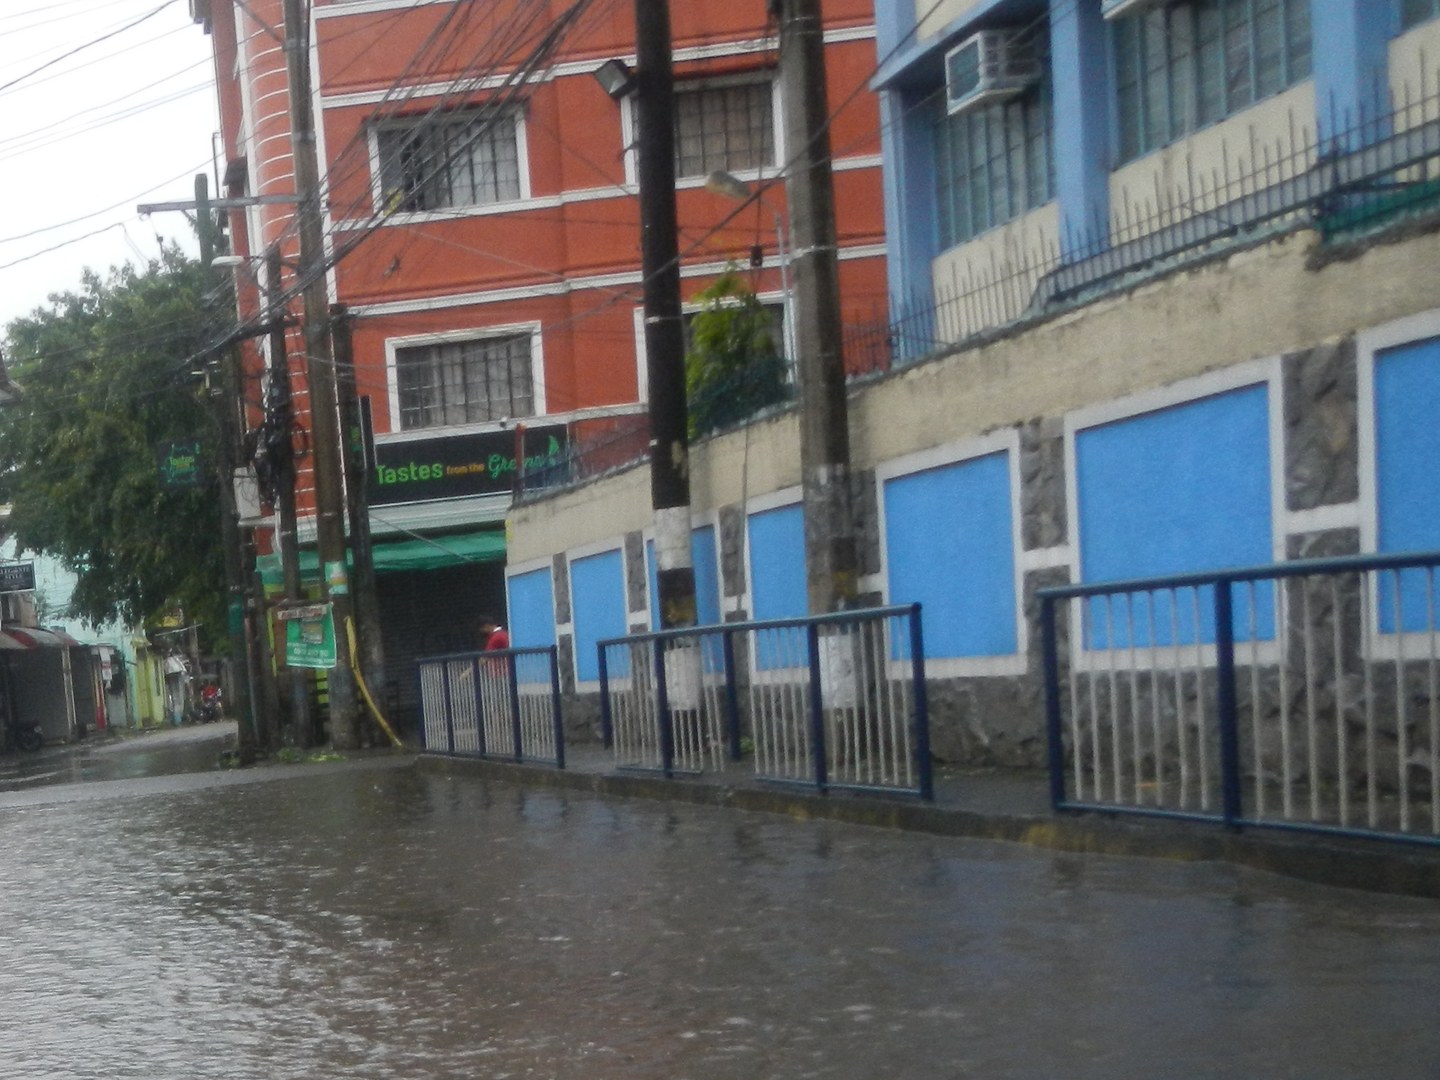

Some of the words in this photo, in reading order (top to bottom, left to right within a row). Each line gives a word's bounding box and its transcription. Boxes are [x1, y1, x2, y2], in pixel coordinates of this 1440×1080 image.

[377, 461, 445, 485] Tastes
[446, 464, 468, 475] from
[469, 462, 485, 474] the
